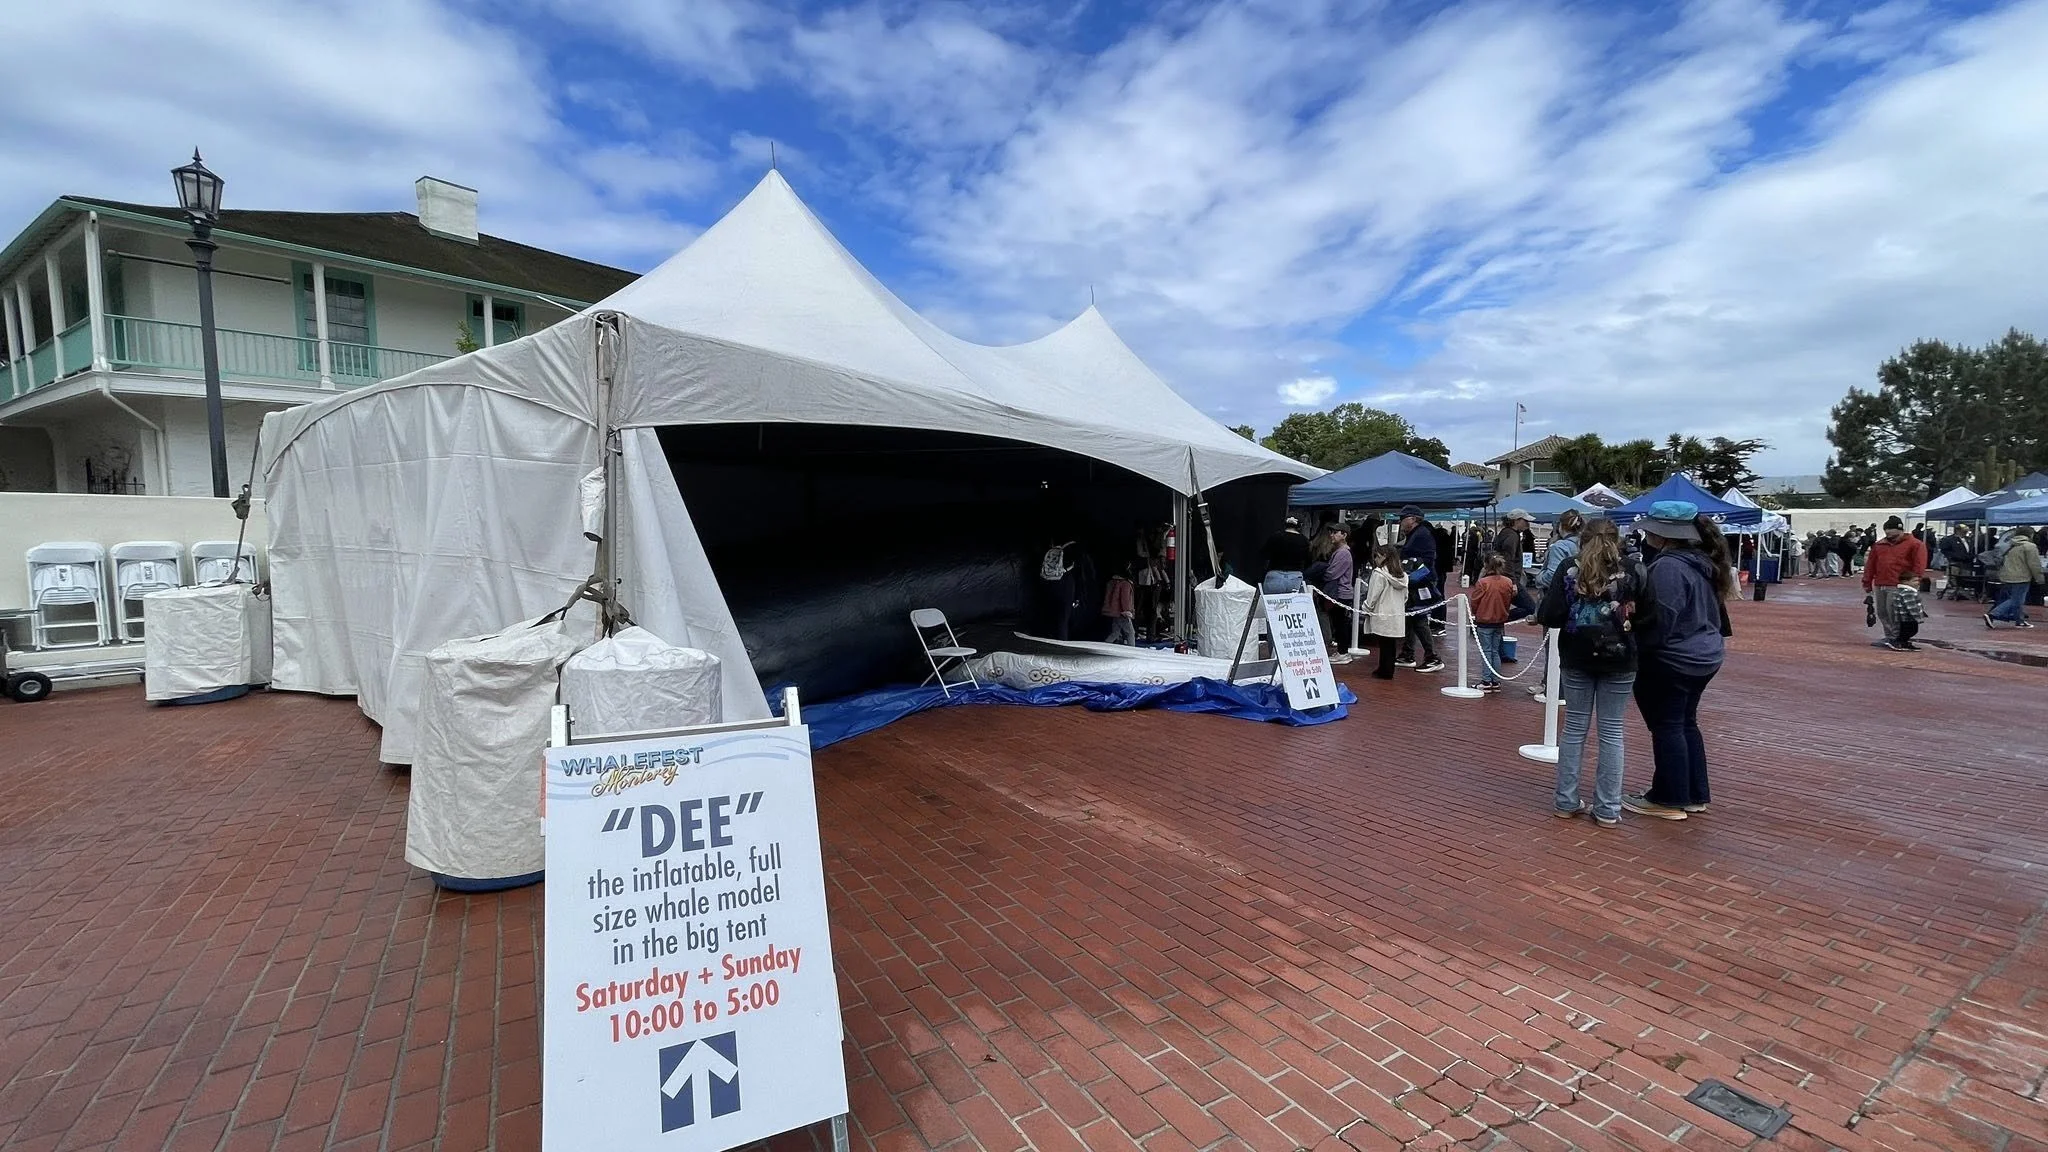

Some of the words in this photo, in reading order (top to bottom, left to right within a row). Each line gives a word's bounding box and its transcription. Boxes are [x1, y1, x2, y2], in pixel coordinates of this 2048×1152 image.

[1278, 613, 1307, 629] "DEE"
[561, 746, 703, 777] WHALEFEST
[591, 765, 679, 797] Monterey
[601, 791, 764, 859] "DEE"
[588, 869, 625, 899] the
[632, 851, 742, 893] inflatable,
[749, 843, 782, 876] full
[593, 905, 637, 934] size
[645, 887, 710, 924] whale
[718, 873, 781, 912] model
[613, 938, 634, 966] in
[642, 928, 679, 960] the
[686, 920, 719, 954] big
[726, 914, 767, 943] tent
[576, 967, 689, 1013] Saturday
[698, 967, 713, 985] +
[722, 944, 802, 981] Sunday
[611, 1000, 684, 1043] 10:00
[694, 1000, 718, 1024] to
[728, 980, 780, 1016] 5:00
